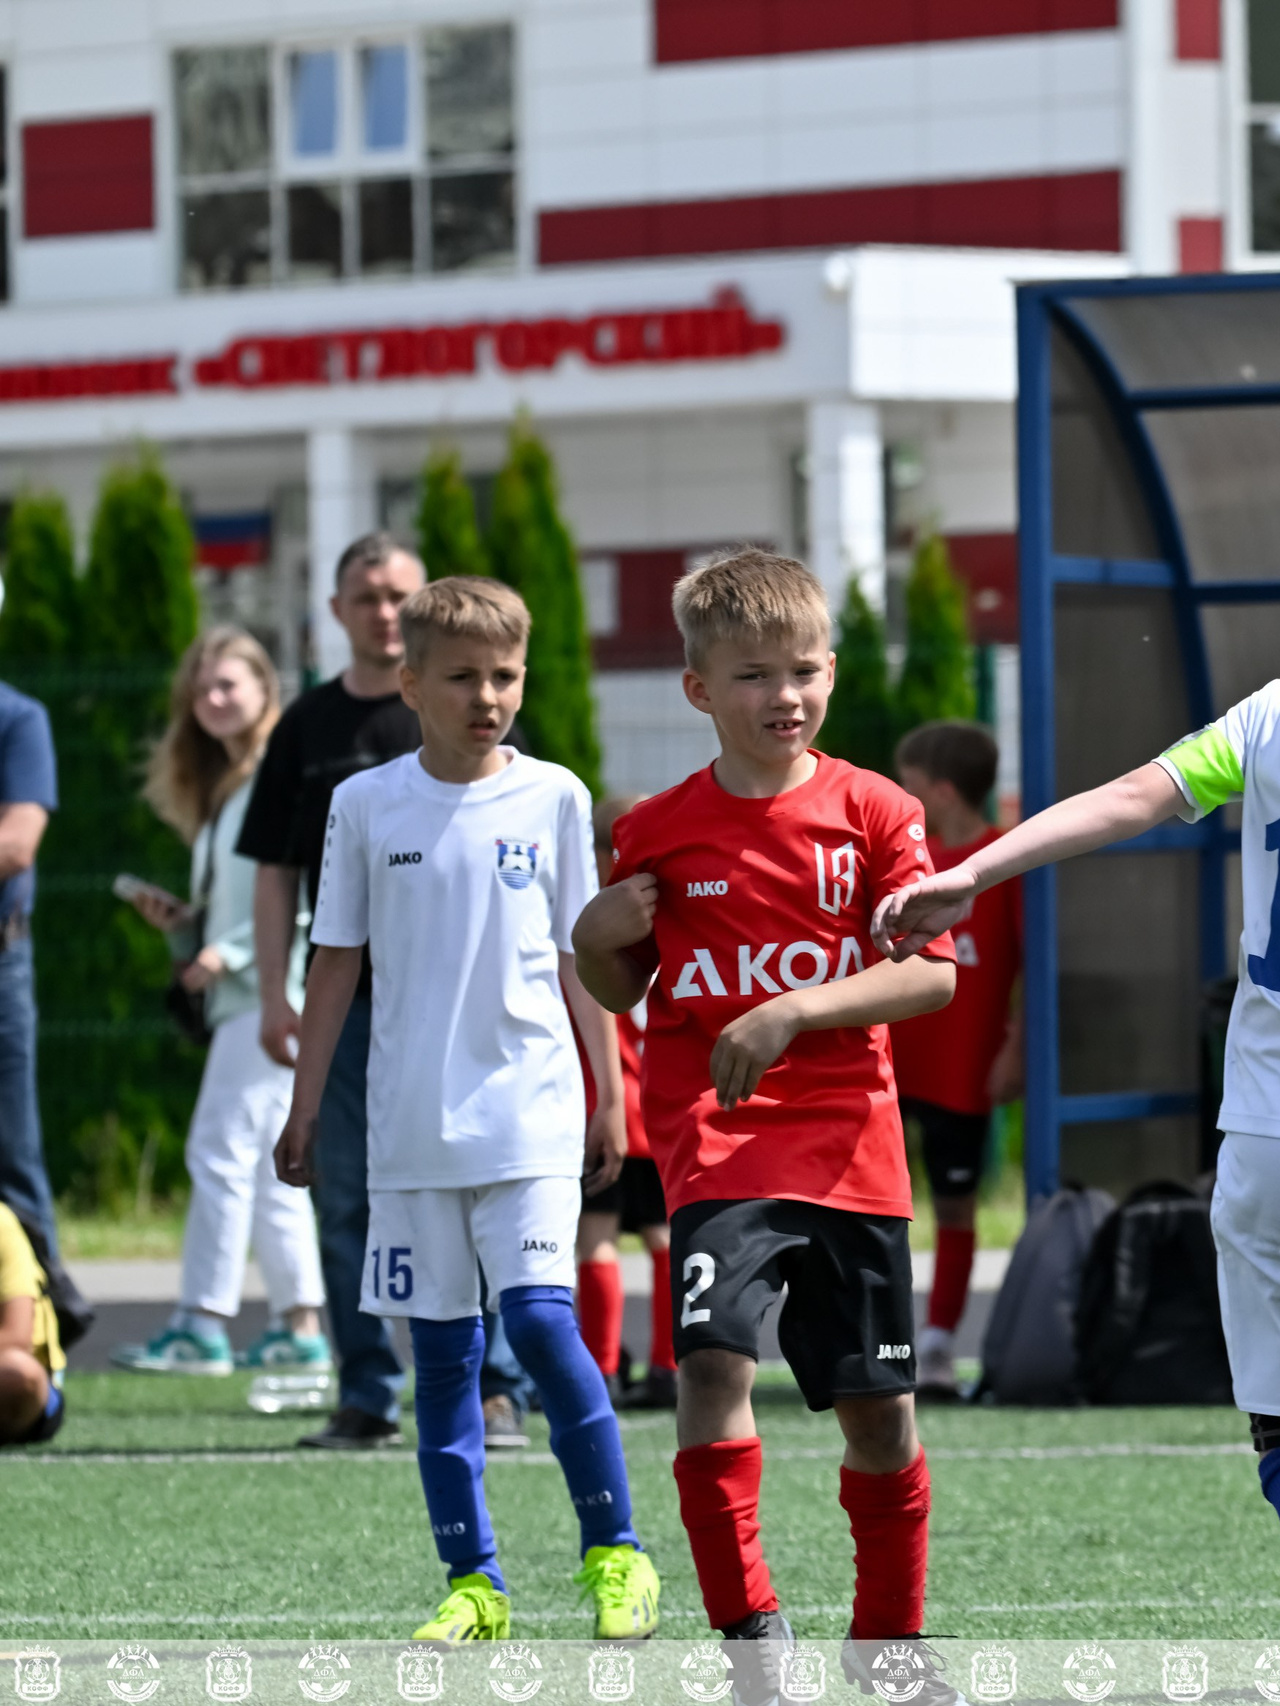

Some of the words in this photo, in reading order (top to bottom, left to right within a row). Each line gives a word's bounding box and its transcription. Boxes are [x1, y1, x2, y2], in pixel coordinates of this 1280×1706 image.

[388, 851, 423, 867] JAKO
[686, 880, 729, 898] JAKO
[522, 1239, 558, 1254] JAKO
[372, 1246, 414, 1301] 15
[680, 1252, 716, 1329] 2
[877, 1344, 911, 1360] JAKO
[573, 1490, 613, 1506] AKO
[433, 1521, 466, 1536] AKO
